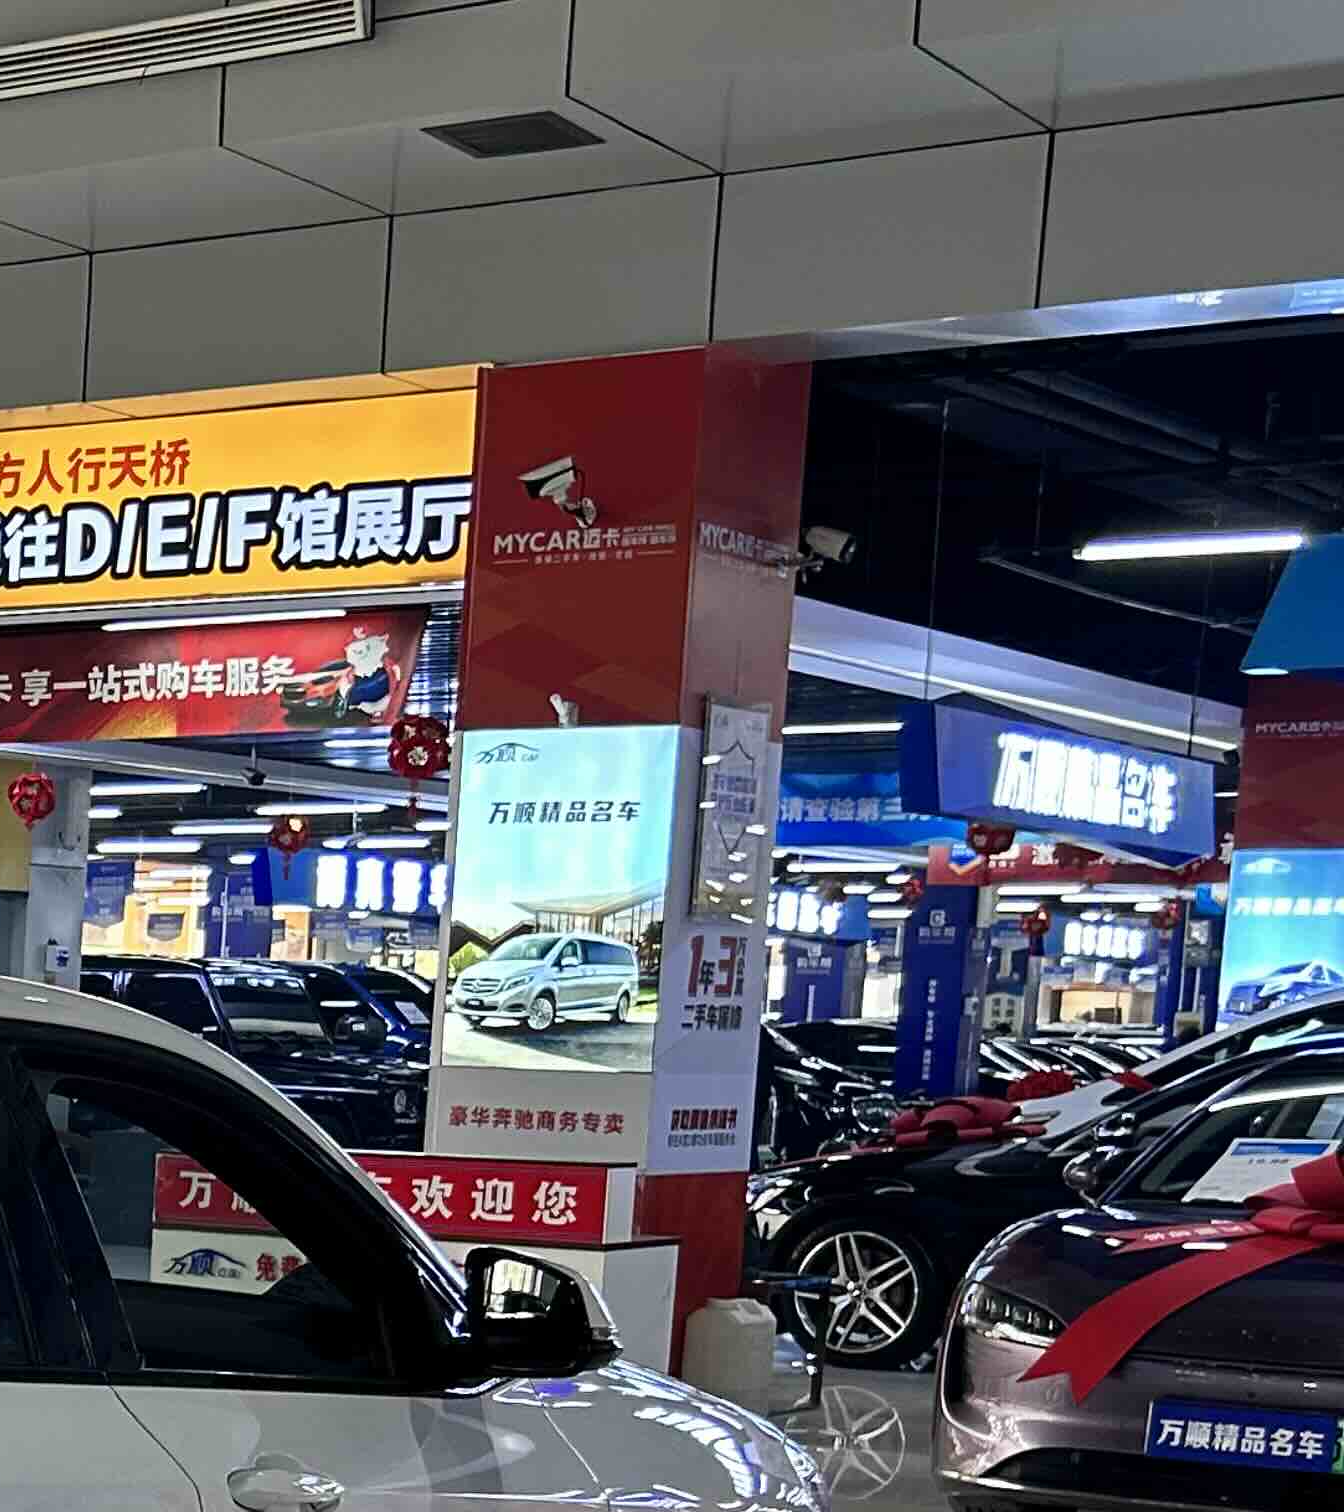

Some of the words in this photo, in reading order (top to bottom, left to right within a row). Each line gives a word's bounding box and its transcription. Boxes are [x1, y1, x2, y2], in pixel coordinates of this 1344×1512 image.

[494, 527, 621, 556] MYCAR迈卡
[20, 655, 297, 704] 享一站式购车服务
[488, 800, 641, 825] 万顺精品名车
[448, 1105, 625, 1135] 豪华奔驰商务专卖
[1156, 1418, 1325, 1460] 万顺精品名车
